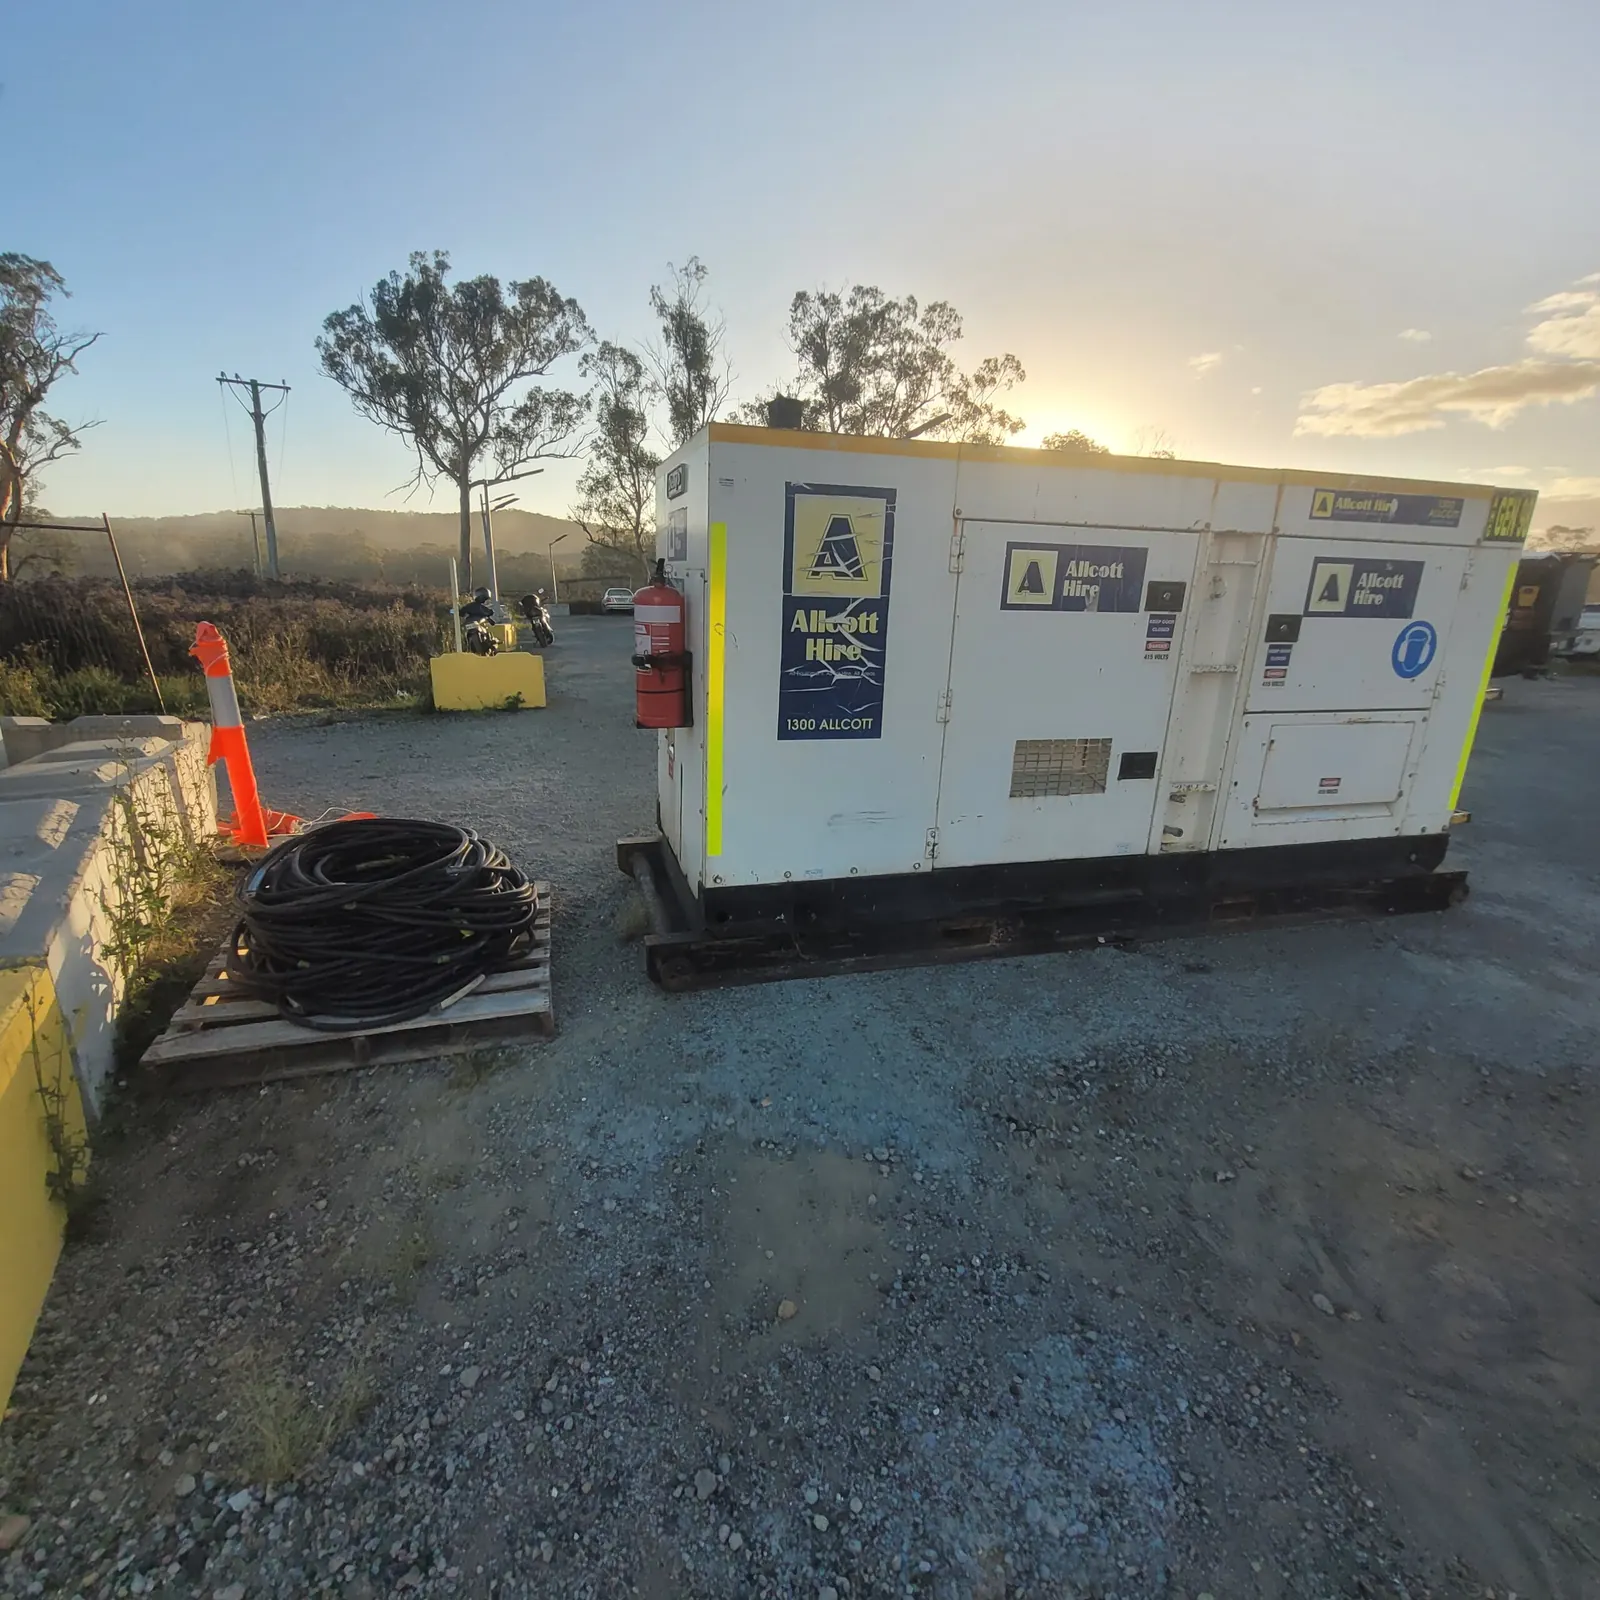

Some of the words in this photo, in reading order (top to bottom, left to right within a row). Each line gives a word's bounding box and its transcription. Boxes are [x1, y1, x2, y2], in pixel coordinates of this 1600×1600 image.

[1335, 497, 1372, 511] Allcott
[1373, 498, 1399, 513] Hir
[1065, 560, 1124, 579] Allcott
[1062, 579, 1100, 597] Hire
[1356, 572, 1405, 589] Allcott
[1353, 589, 1384, 606] Hire
[790, 609, 880, 634] Allcott
[805, 638, 862, 661] Hire
[1154, 653, 1169, 661] VOLTS
[786, 718, 816, 731] 1300
[818, 718, 874, 730] ALLCOTT
